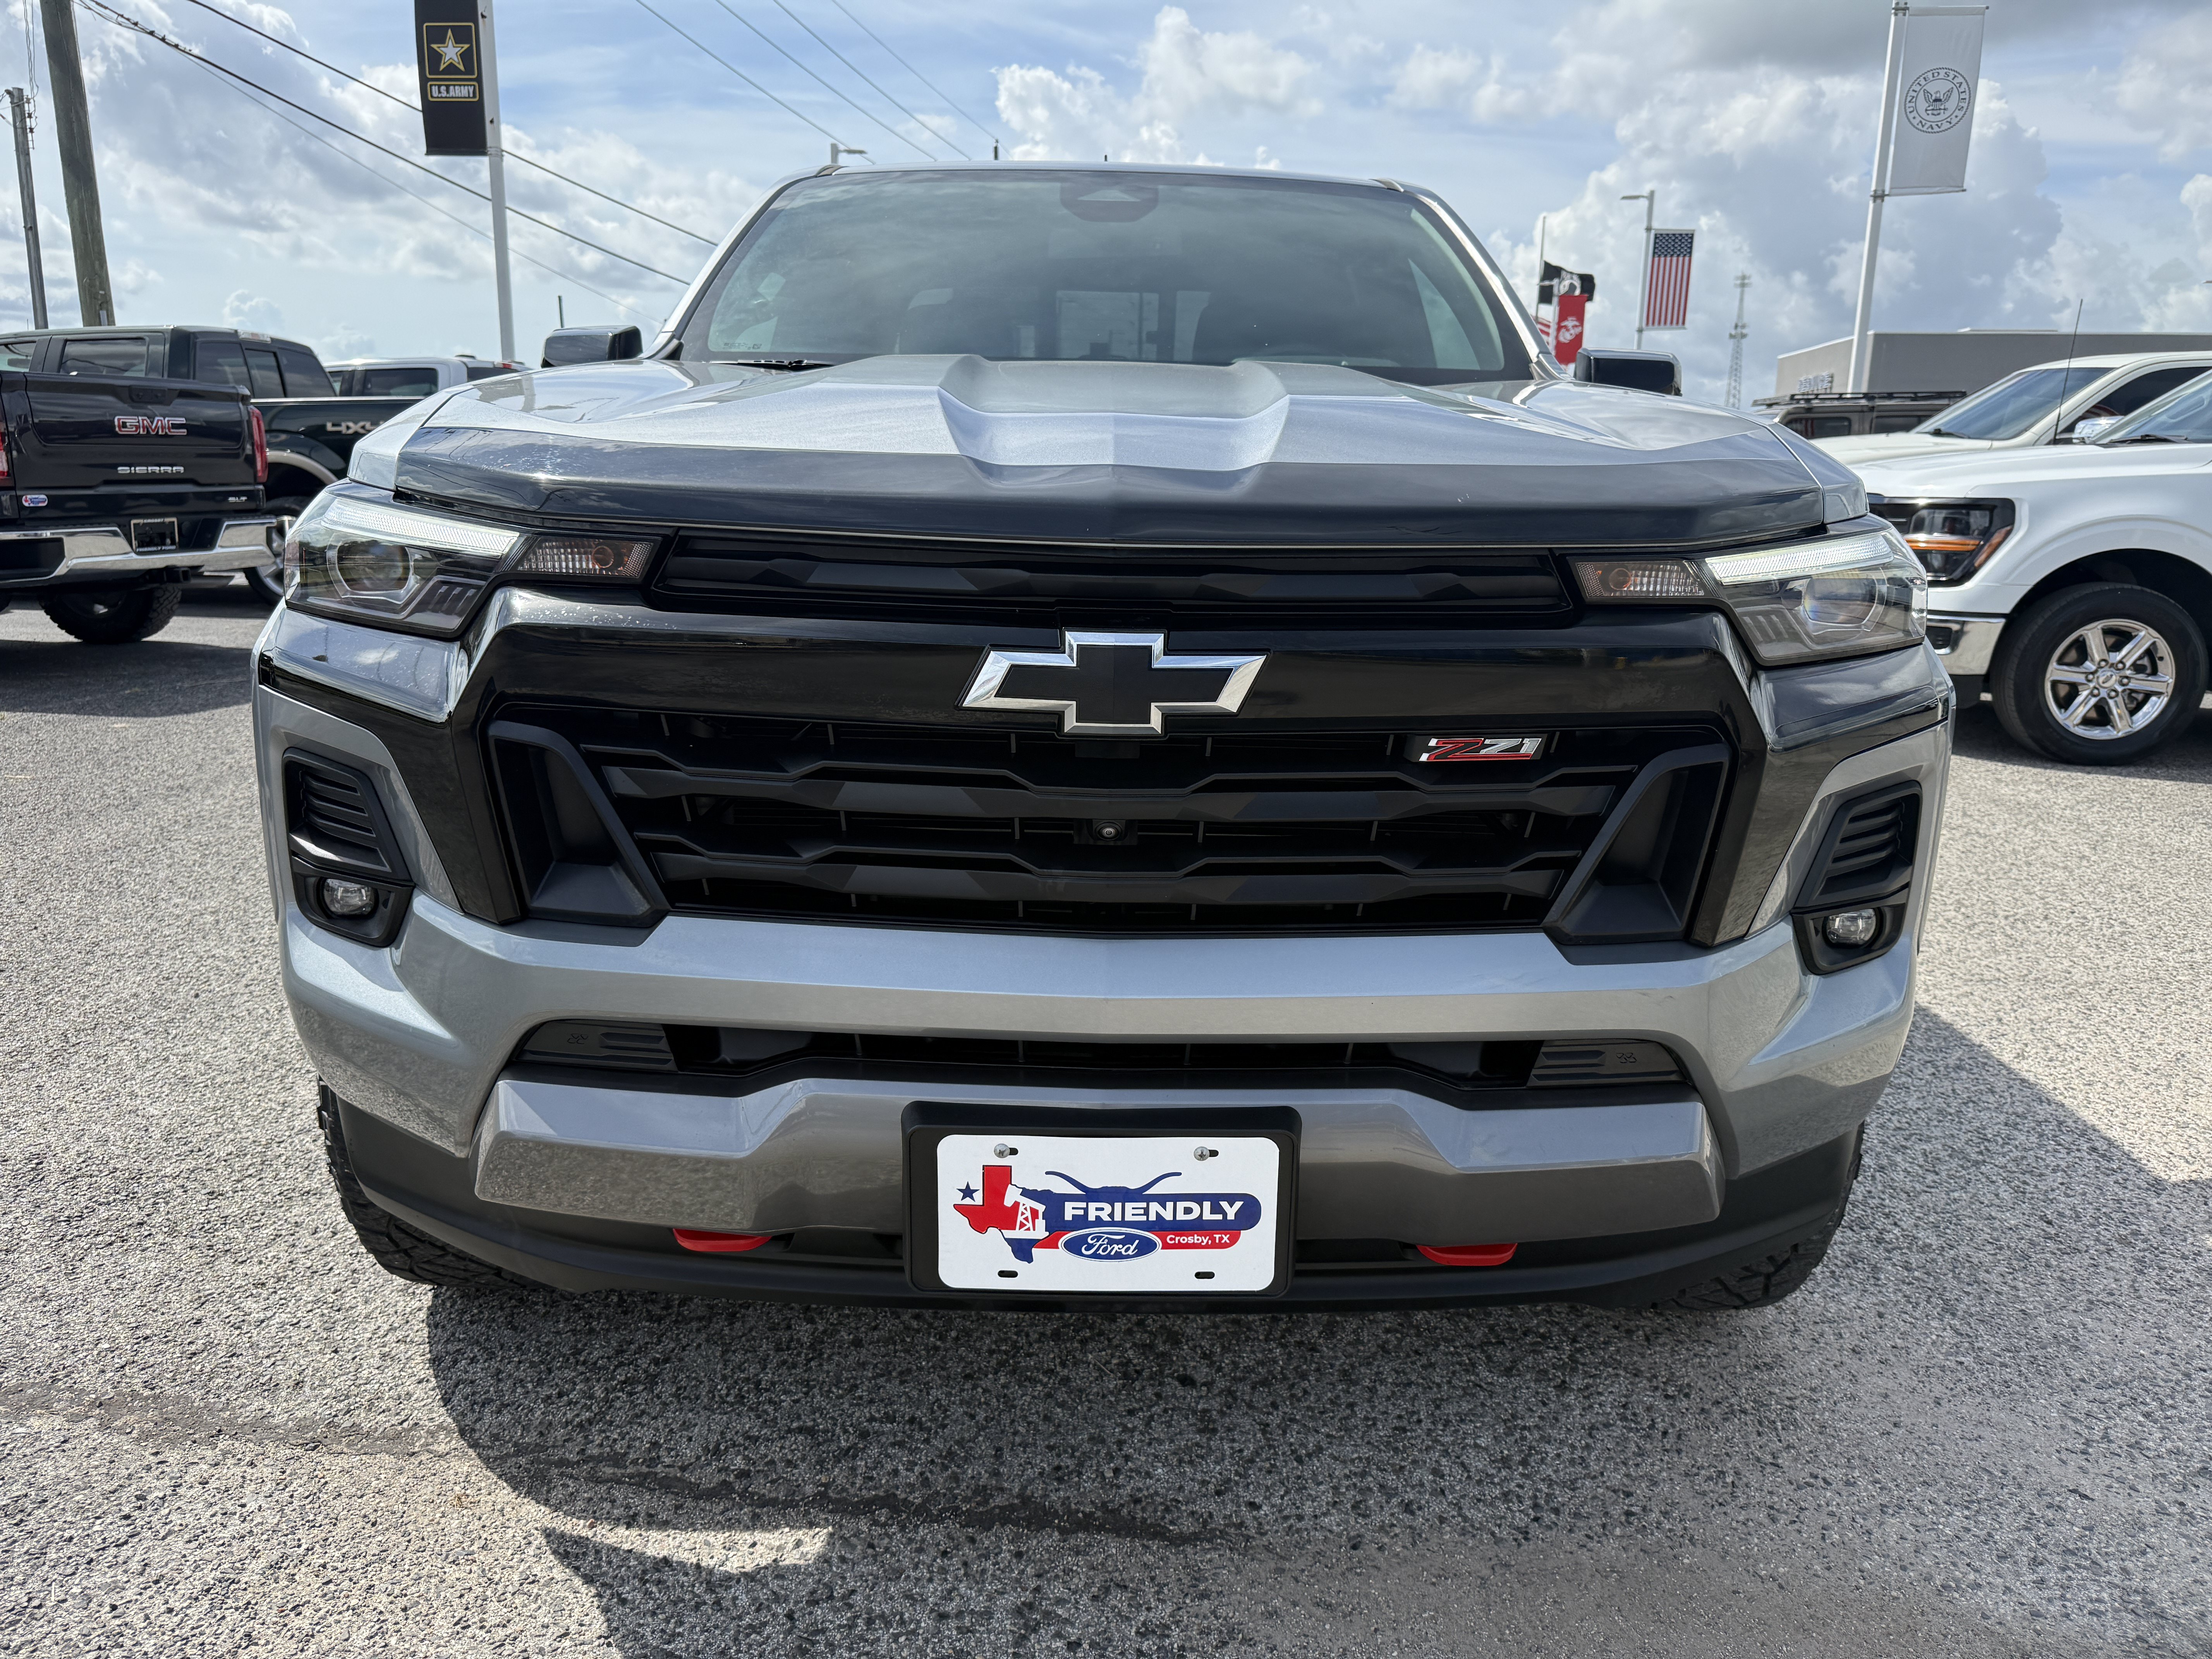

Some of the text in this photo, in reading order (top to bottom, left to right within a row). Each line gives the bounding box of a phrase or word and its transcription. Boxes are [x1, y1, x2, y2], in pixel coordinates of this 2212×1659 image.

[1908, 71, 1967, 114] UNITED STATES
[1917, 118, 1953, 130] NAVY
[114, 416, 187, 435] GMC
[1419, 738, 1542, 762] Z71
[1064, 1201, 1244, 1221] FRIENDLY
[1081, 1233, 1139, 1255] Ford
[1166, 1234, 1230, 1245] Crosby, TX
